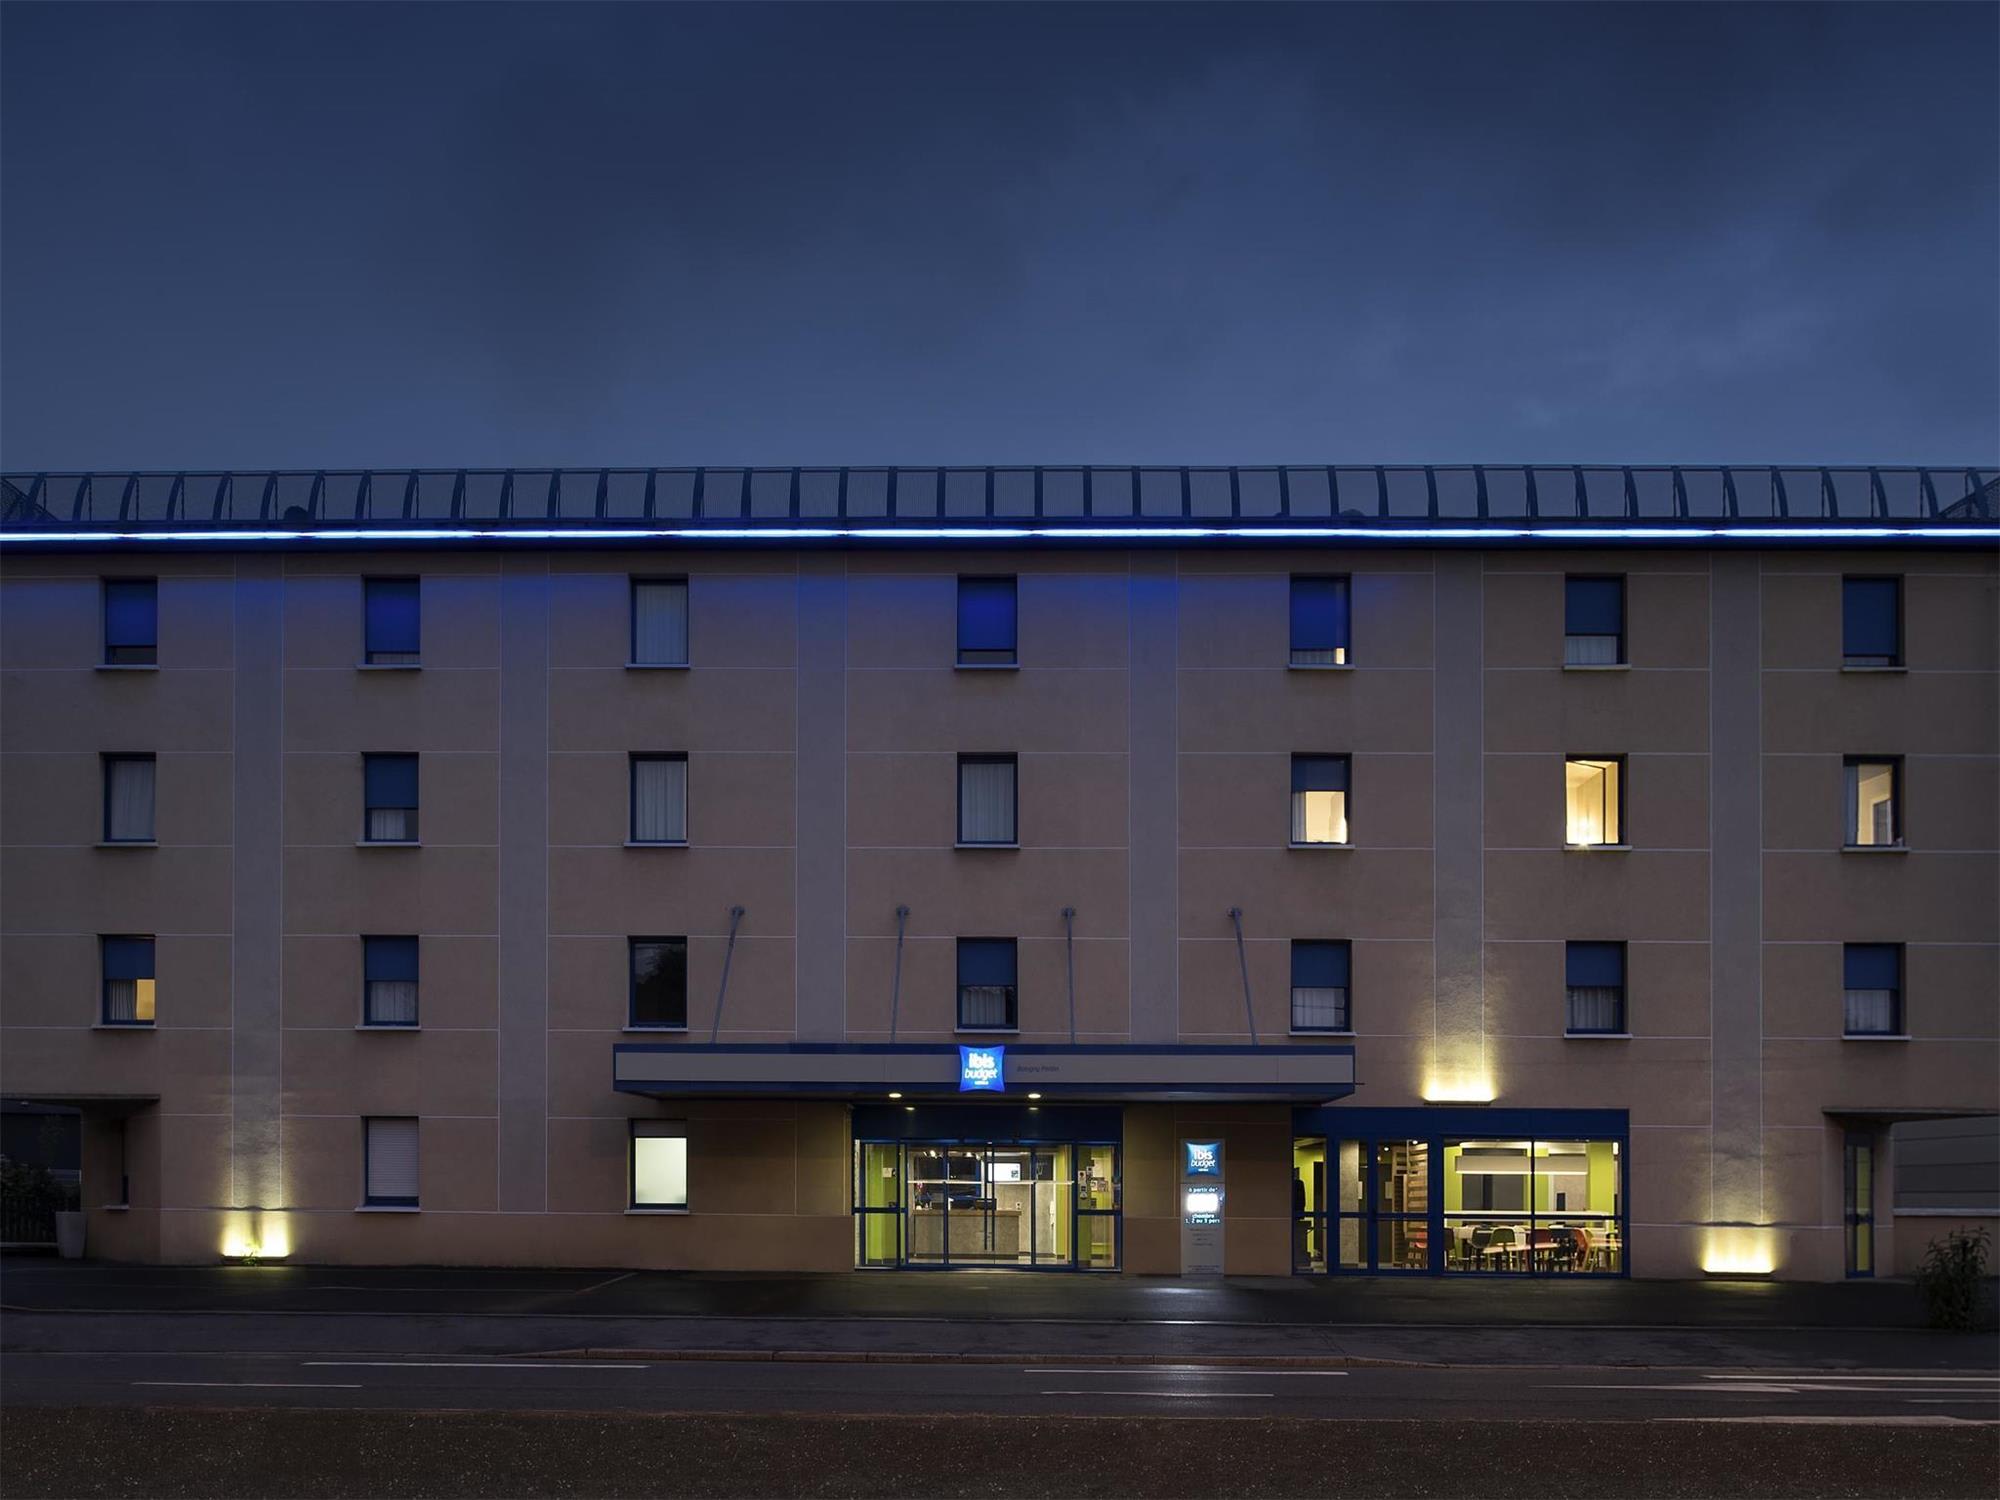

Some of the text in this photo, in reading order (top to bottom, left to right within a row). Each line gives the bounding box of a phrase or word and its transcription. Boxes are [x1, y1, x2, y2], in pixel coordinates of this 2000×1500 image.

[968, 1052, 995, 1068] ibis
[964, 1068, 998, 1081] budget
[1194, 1149, 1213, 1160] ibis
[1191, 1160, 1216, 1169] budget
